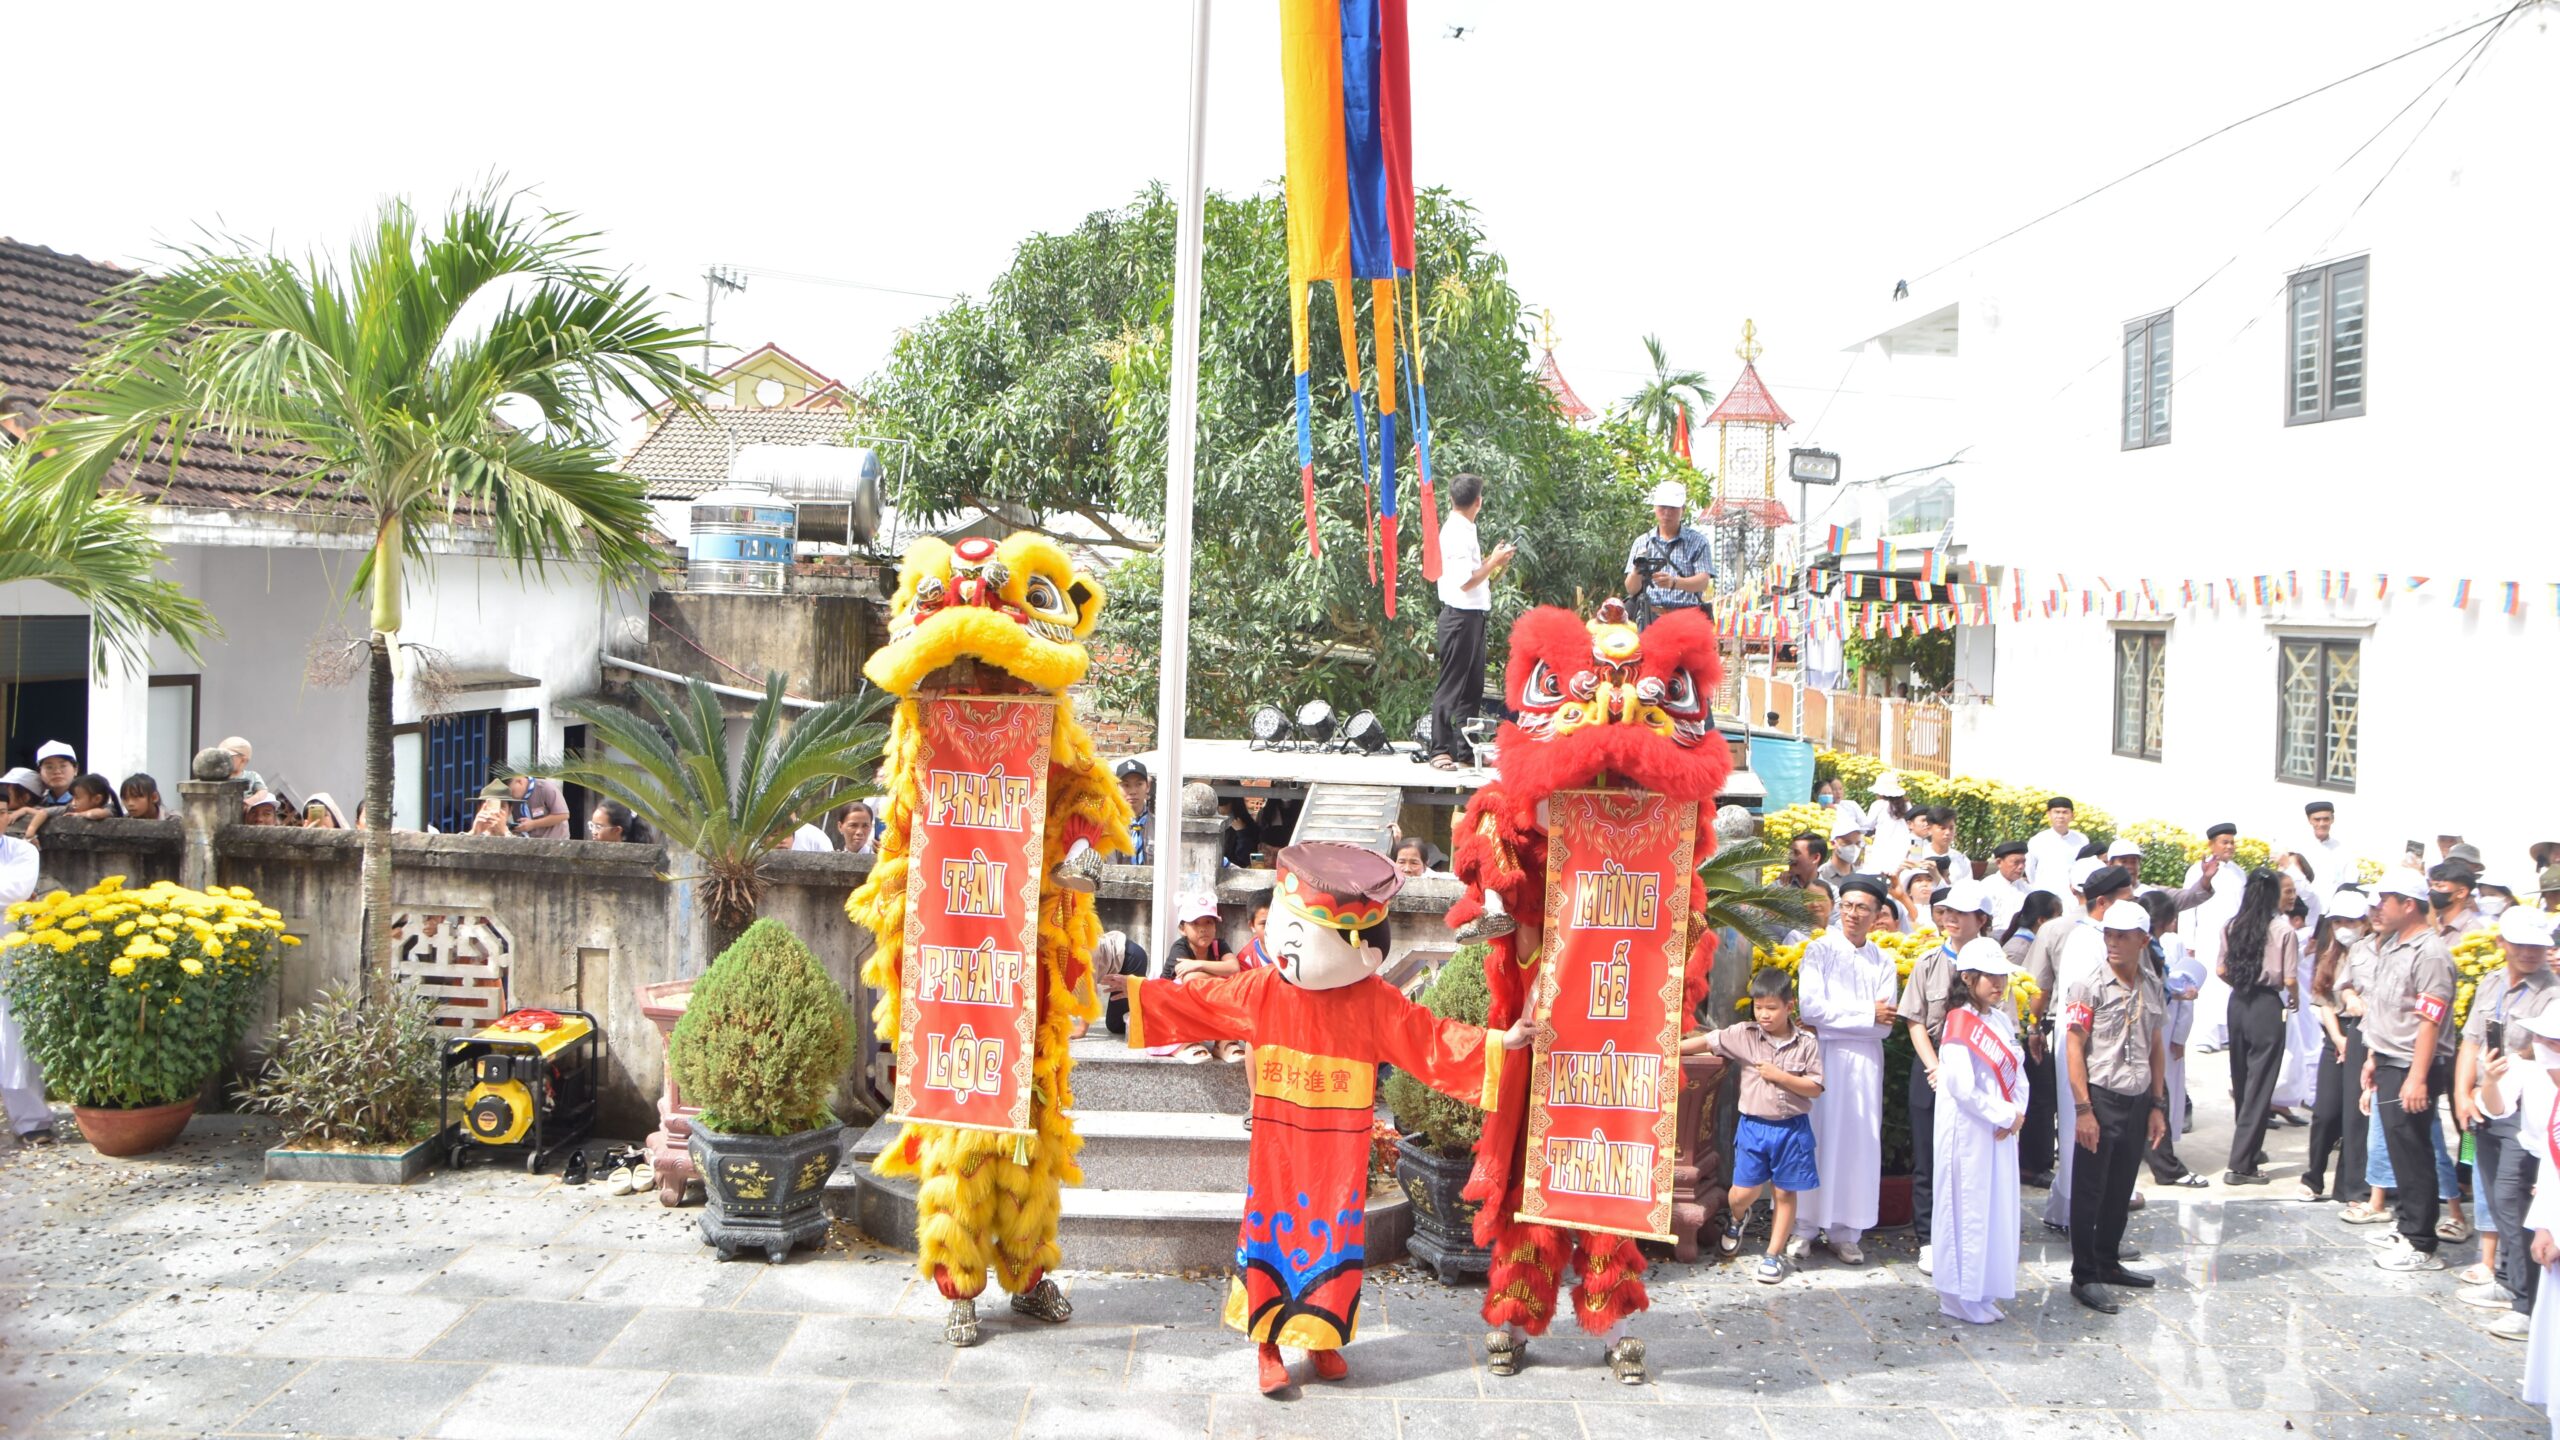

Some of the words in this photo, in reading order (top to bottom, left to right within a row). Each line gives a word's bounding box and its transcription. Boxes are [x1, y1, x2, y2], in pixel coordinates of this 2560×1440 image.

[928, 765, 1030, 831] PHÁT
[944, 849, 1006, 917] TÀI
[1572, 861, 1658, 928] MỪNG
[920, 938, 1021, 1006] PHÁT
[1588, 941, 1629, 1018] LỄ
[926, 1025, 1003, 1103] LỘC
[1262, 1060, 1351, 1093] 招財進寶
[1549, 1041, 1661, 1109] KHÁNH
[1549, 1129, 1653, 1199] THÀNH
